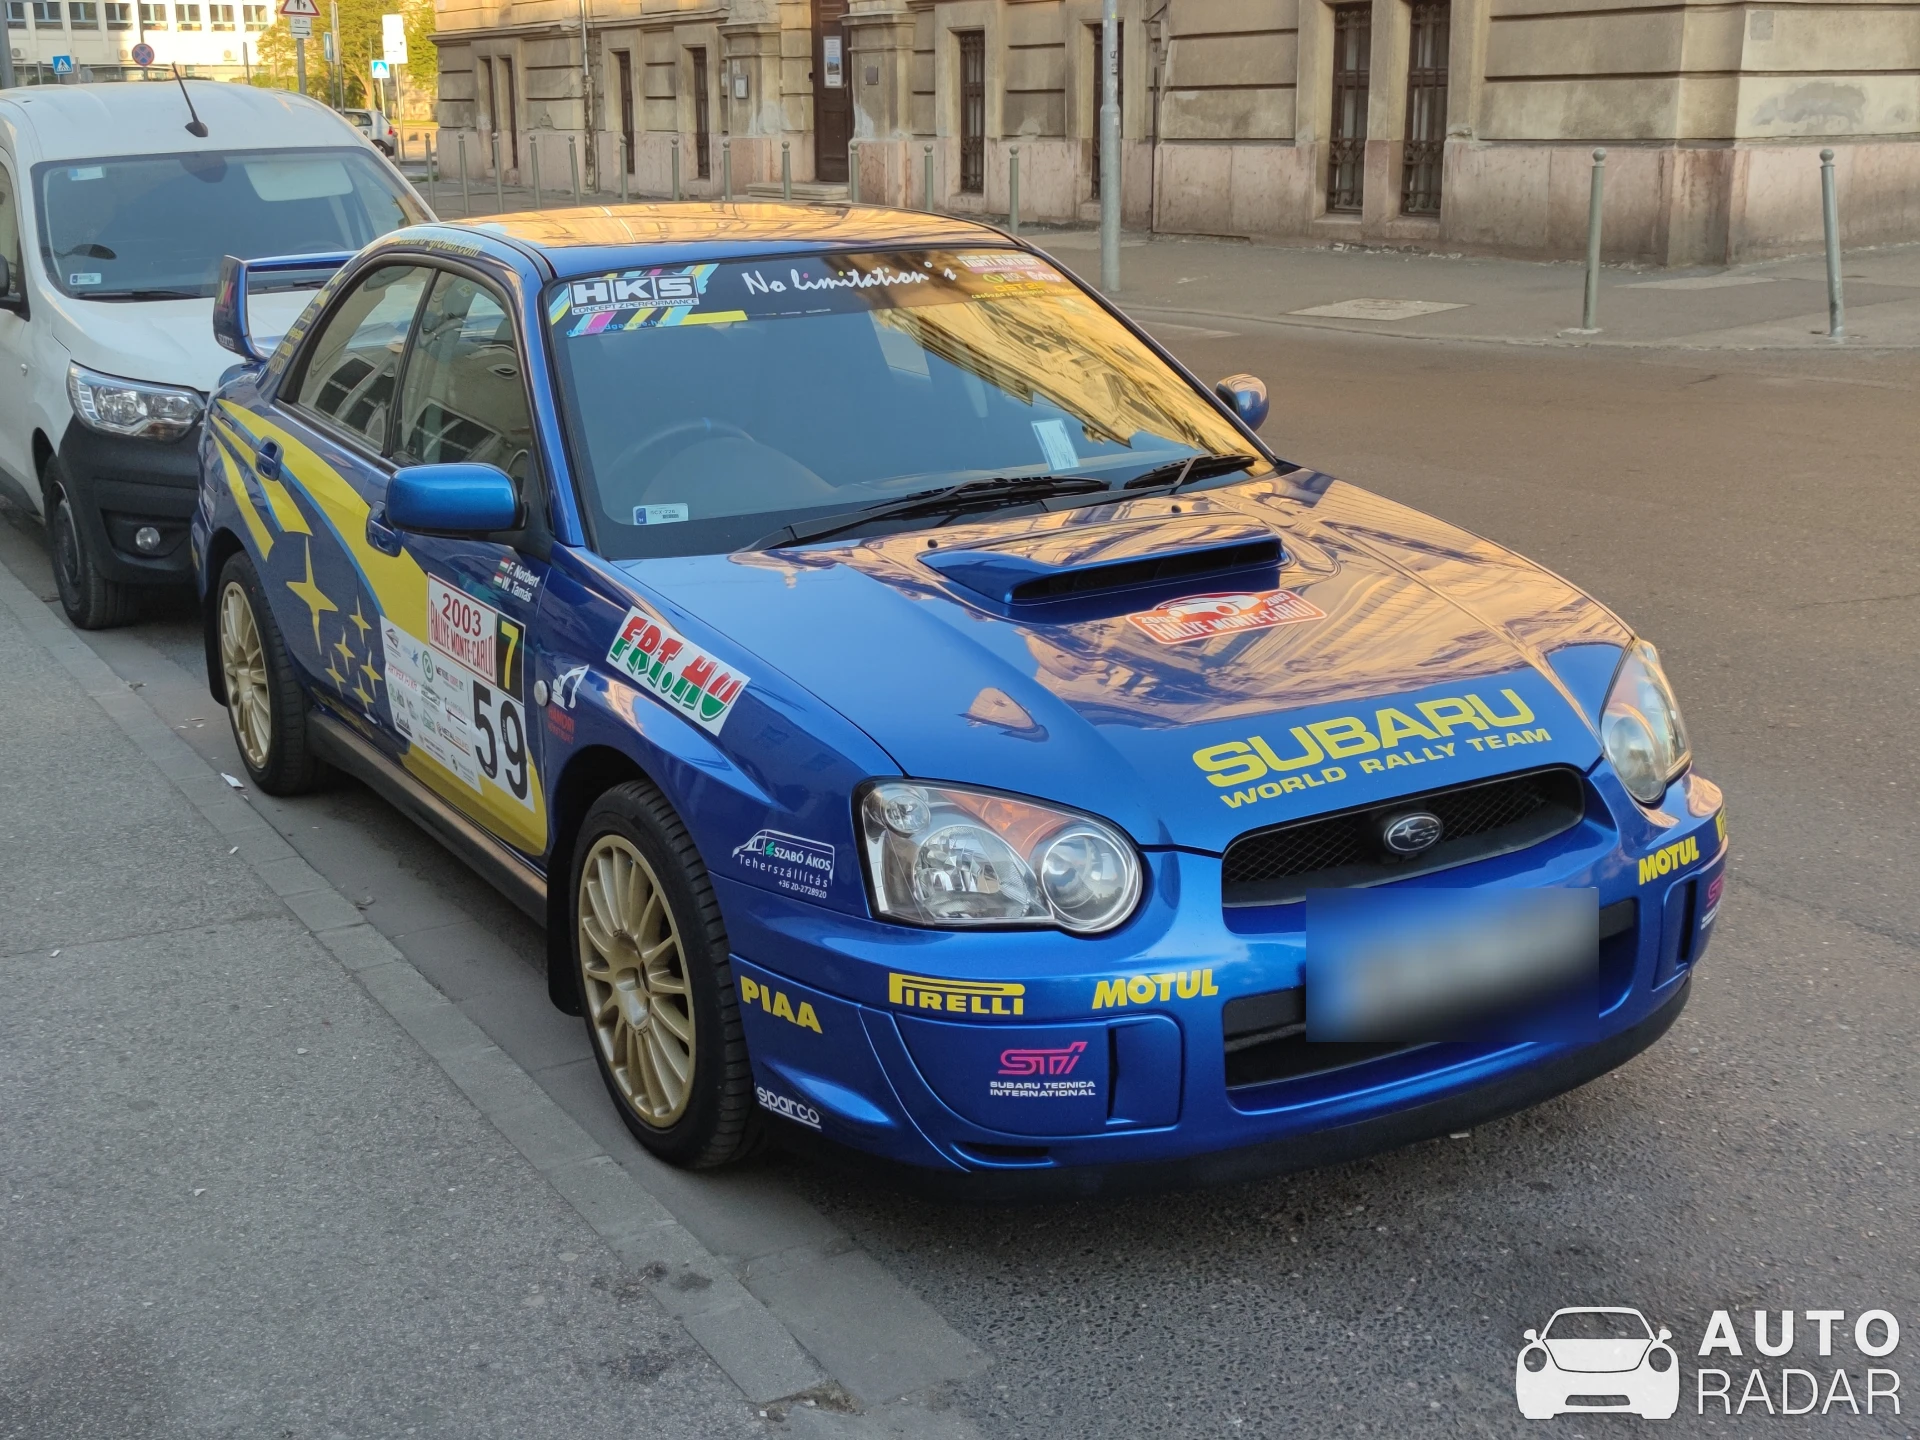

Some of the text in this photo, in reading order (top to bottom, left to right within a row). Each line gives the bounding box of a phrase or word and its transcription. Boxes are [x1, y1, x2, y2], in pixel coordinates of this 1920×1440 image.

[573, 278, 693, 304] HKS
[742, 270, 787, 295] No
[573, 303, 617, 313] CONCEPT
[502, 576, 532, 602] W. Tamás
[507, 562, 541, 587] F. Norbert
[1263, 592, 1291, 606] 2003
[442, 593, 481, 636] 2003
[1136, 615, 1181, 624] 2003
[430, 599, 450, 651] RALLYE
[451, 628, 493, 677] MONTE-CARLO
[1144, 620, 1214, 641] RALLYE
[501, 620, 519, 690] 7
[473, 680, 527, 800] 59
[1192, 688, 1536, 788] SUBARU
[1220, 728, 1553, 809] WORLD RALLY TEAM
[739, 854, 828, 888] Teherszállítás
[774, 847, 831, 871] SZABÓ ÁKOS
[1638, 836, 1699, 885] MOTUL
[778, 880, 790, 889] +36
[740, 975, 823, 1034] PIAA
[888, 972, 1026, 1015] PIRELLI
[1092, 969, 1219, 1010] MOTUL
[990, 1081, 1096, 1089] SUBARU TECNICA
[990, 1089, 1096, 1097] INTERNATIONAL
[756, 1086, 821, 1128] sparco
